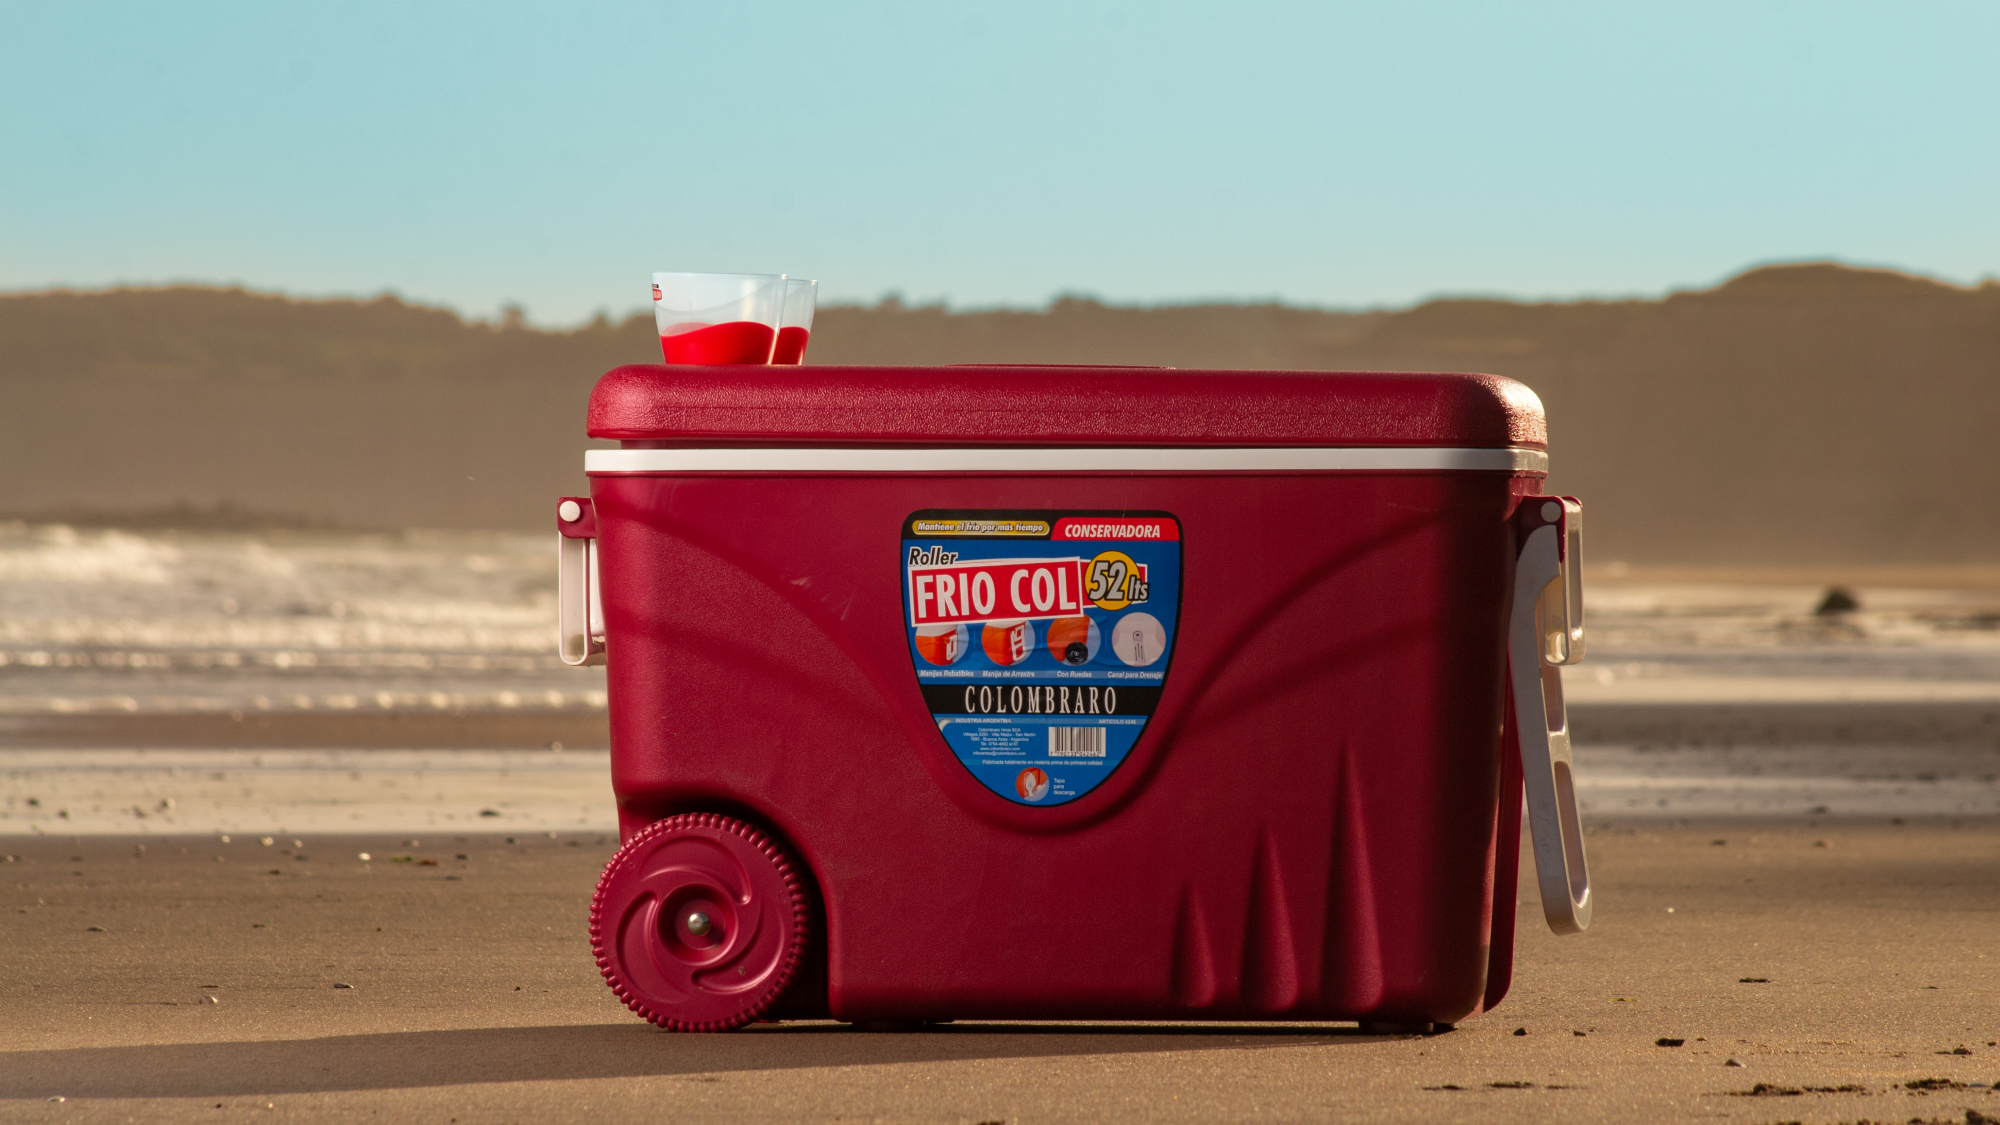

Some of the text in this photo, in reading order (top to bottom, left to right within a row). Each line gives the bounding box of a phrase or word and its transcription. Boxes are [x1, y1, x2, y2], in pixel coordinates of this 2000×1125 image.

[917, 522, 955, 531] Mantiene
[956, 522, 964, 531] el
[981, 524, 996, 533] por
[1015, 523, 1044, 533] tiempo
[1064, 524, 1161, 538] CONSERVADORA
[908, 546, 958, 566] Roller
[1088, 560, 1126, 601] 52
[916, 567, 1077, 619] FRIO COL
[920, 670, 942, 678] Manijas
[982, 670, 1002, 678] Manija
[965, 685, 1116, 714] COLOMBRARO
